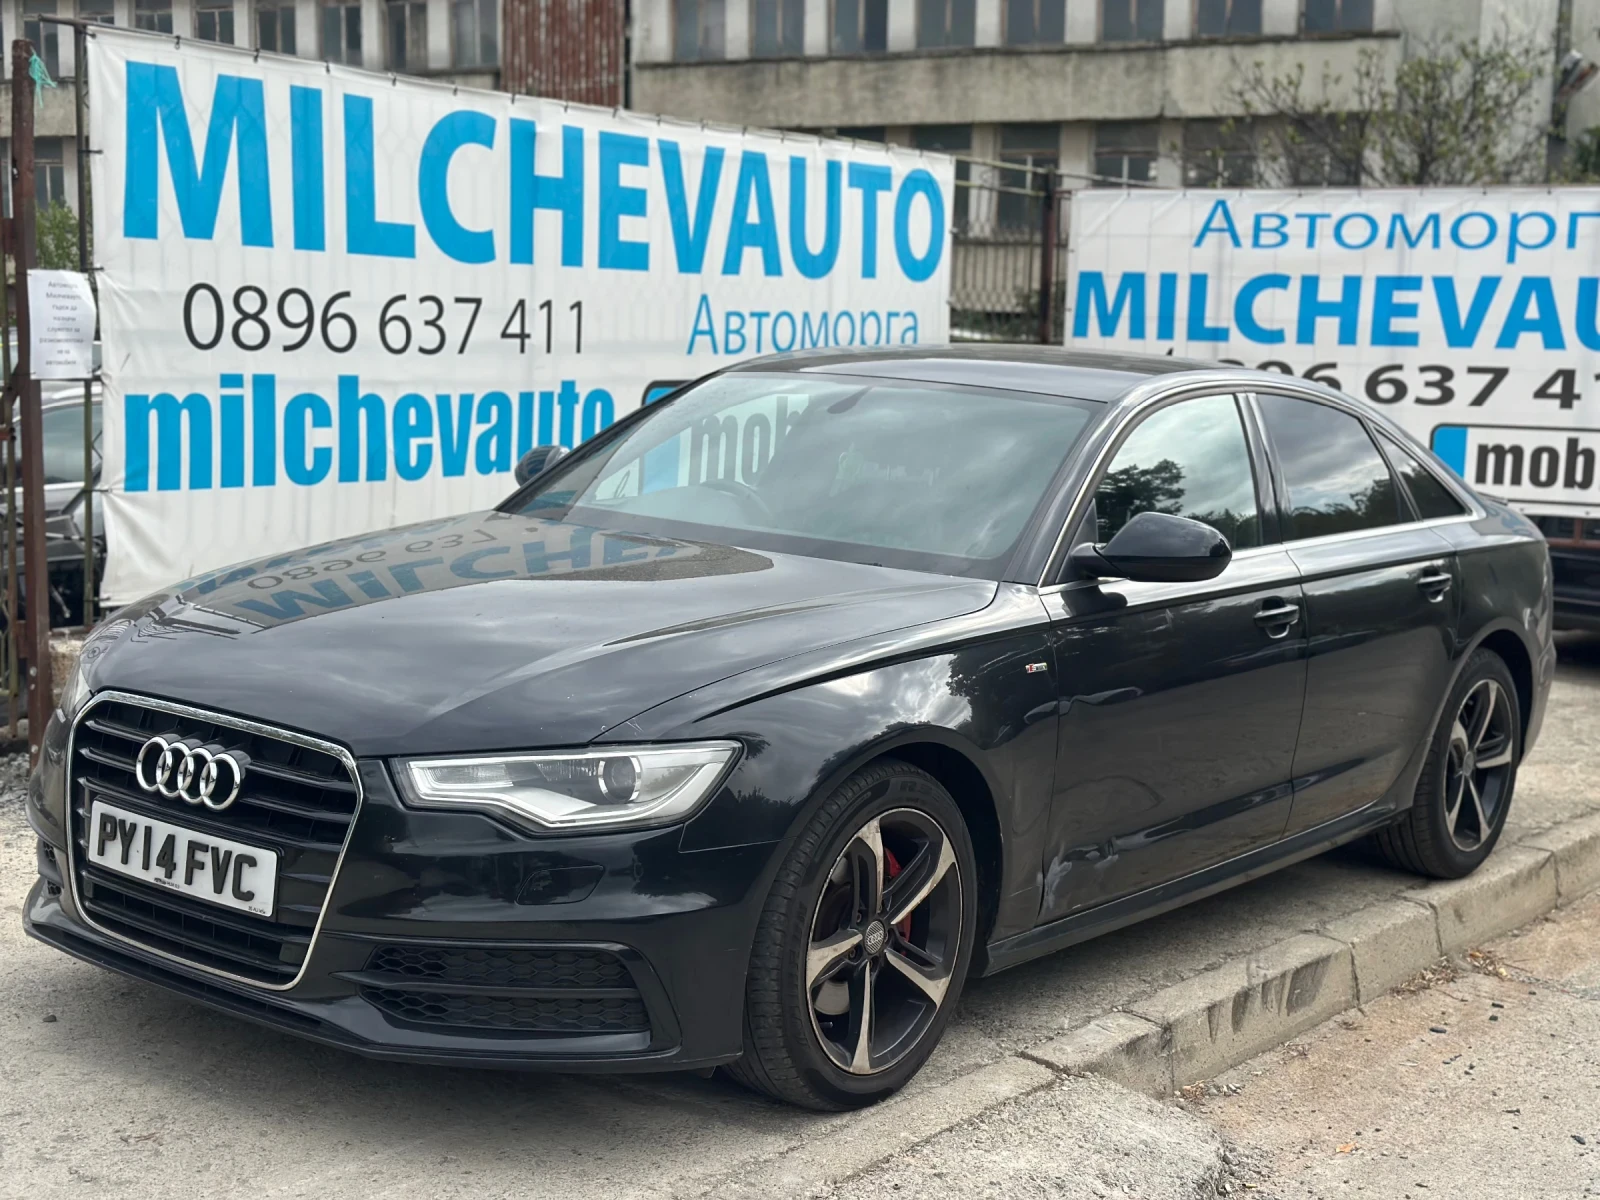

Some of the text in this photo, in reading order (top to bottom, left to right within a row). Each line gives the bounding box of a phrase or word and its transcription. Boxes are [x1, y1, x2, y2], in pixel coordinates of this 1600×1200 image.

[123, 60, 945, 283] MILCHEVAUTO
[1193, 200, 1600, 264] Автоморг
[183, 283, 583, 355] 0896 637 411
[686, 293, 918, 355] Автоморга
[1365, 364, 1510, 406] 637
[124, 373, 614, 492] milchevauto
[97, 812, 258, 902] PY14 FVC
